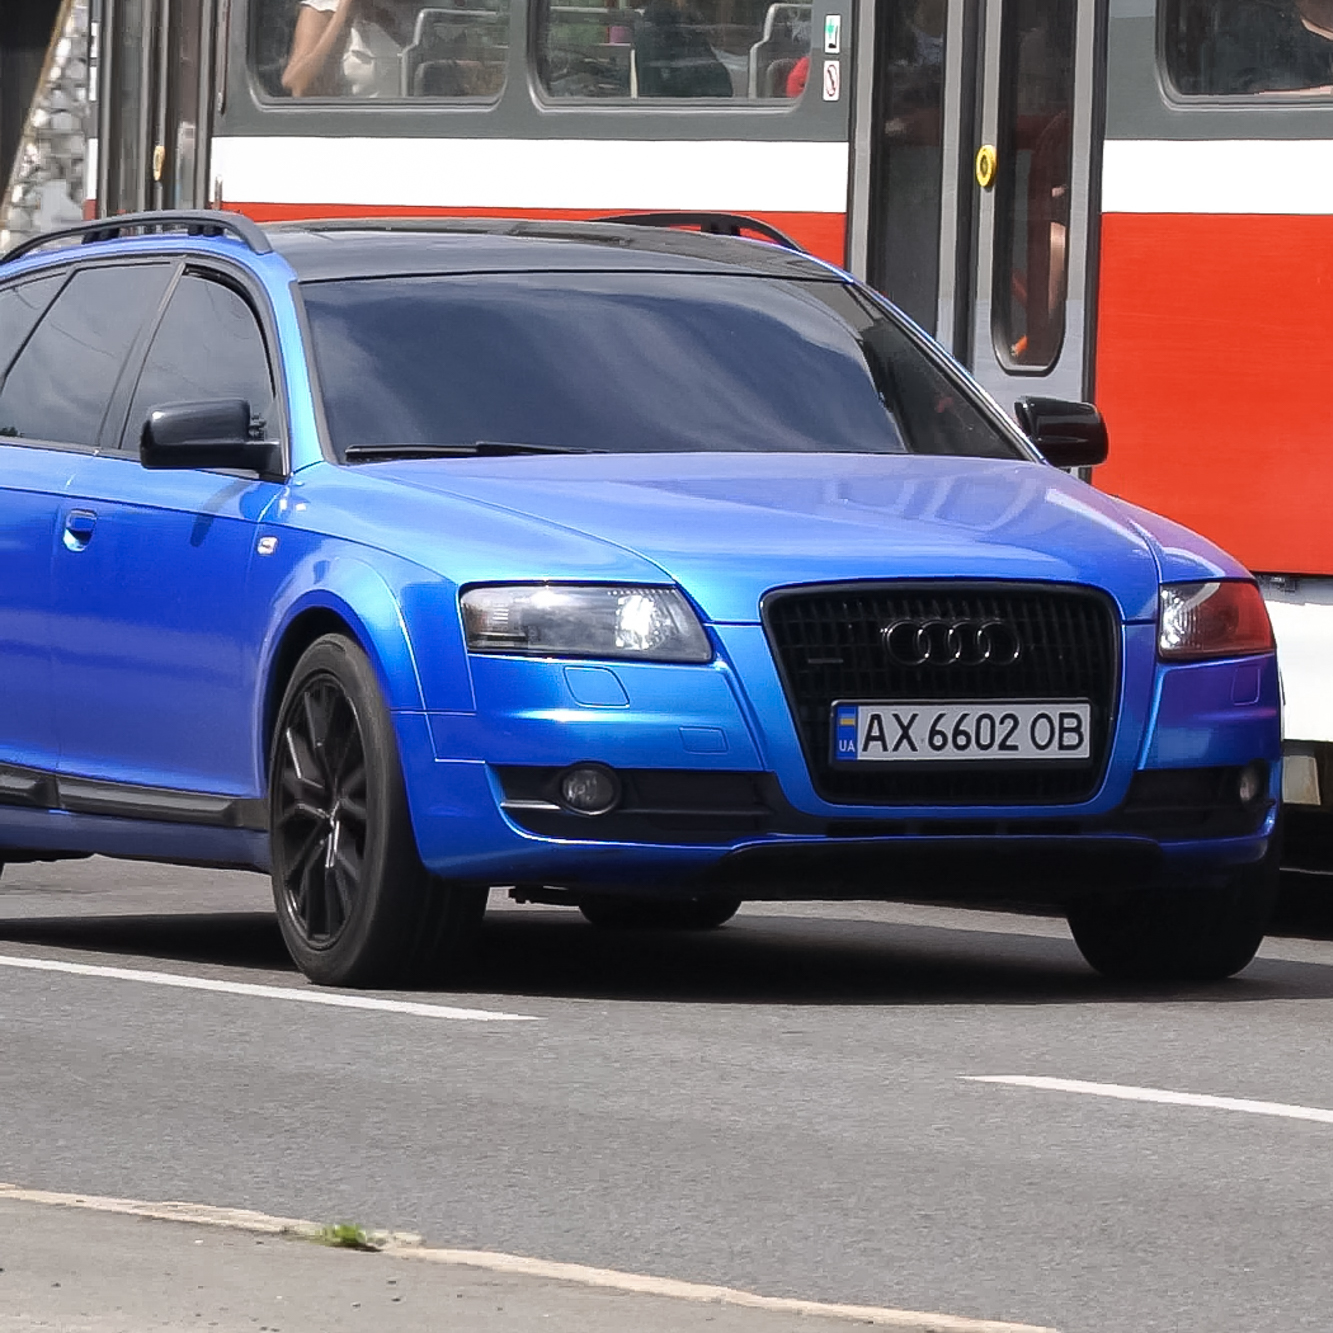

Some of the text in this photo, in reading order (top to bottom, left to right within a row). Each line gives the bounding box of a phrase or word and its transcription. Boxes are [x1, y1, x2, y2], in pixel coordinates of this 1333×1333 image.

[862, 712, 1085, 752] AX 6602 OB
[838, 739, 856, 753] UA
